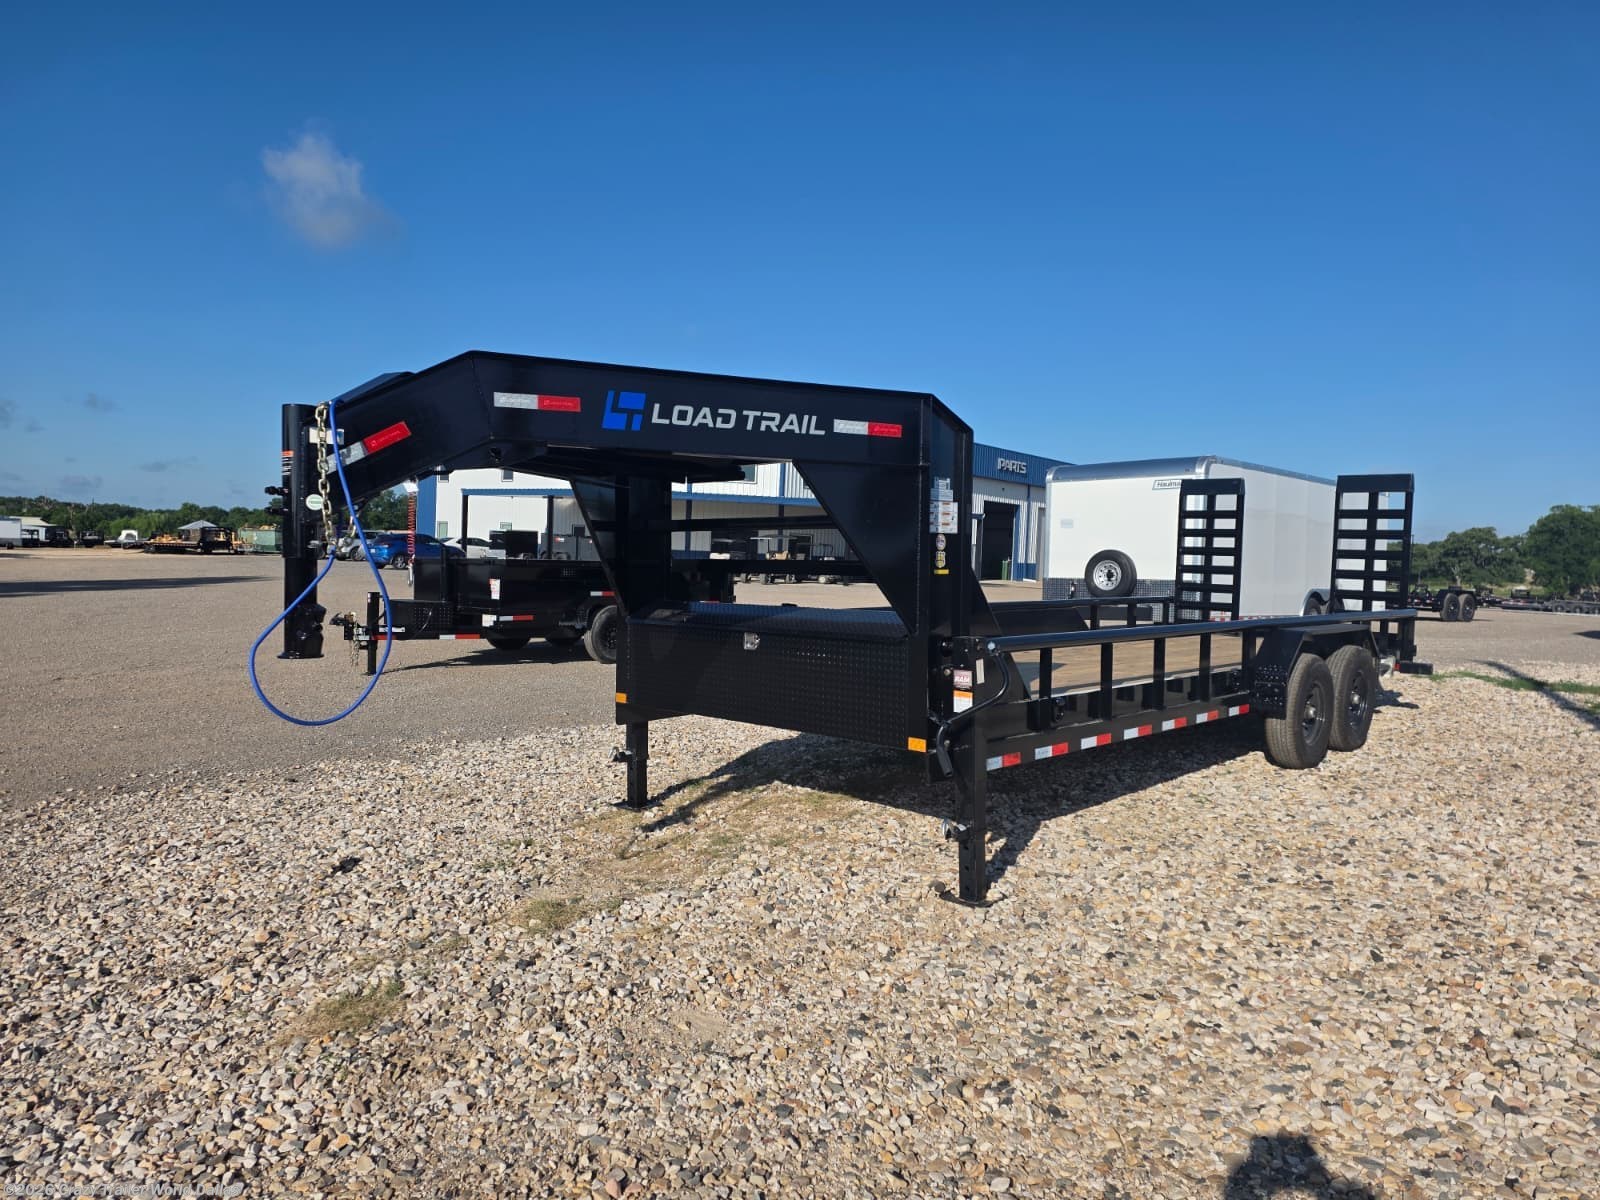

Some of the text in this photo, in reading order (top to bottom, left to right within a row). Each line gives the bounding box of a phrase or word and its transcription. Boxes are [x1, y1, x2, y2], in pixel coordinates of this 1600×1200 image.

[651, 403, 826, 435] LOAD TRAIL
[997, 458, 1027, 474] PARTS
